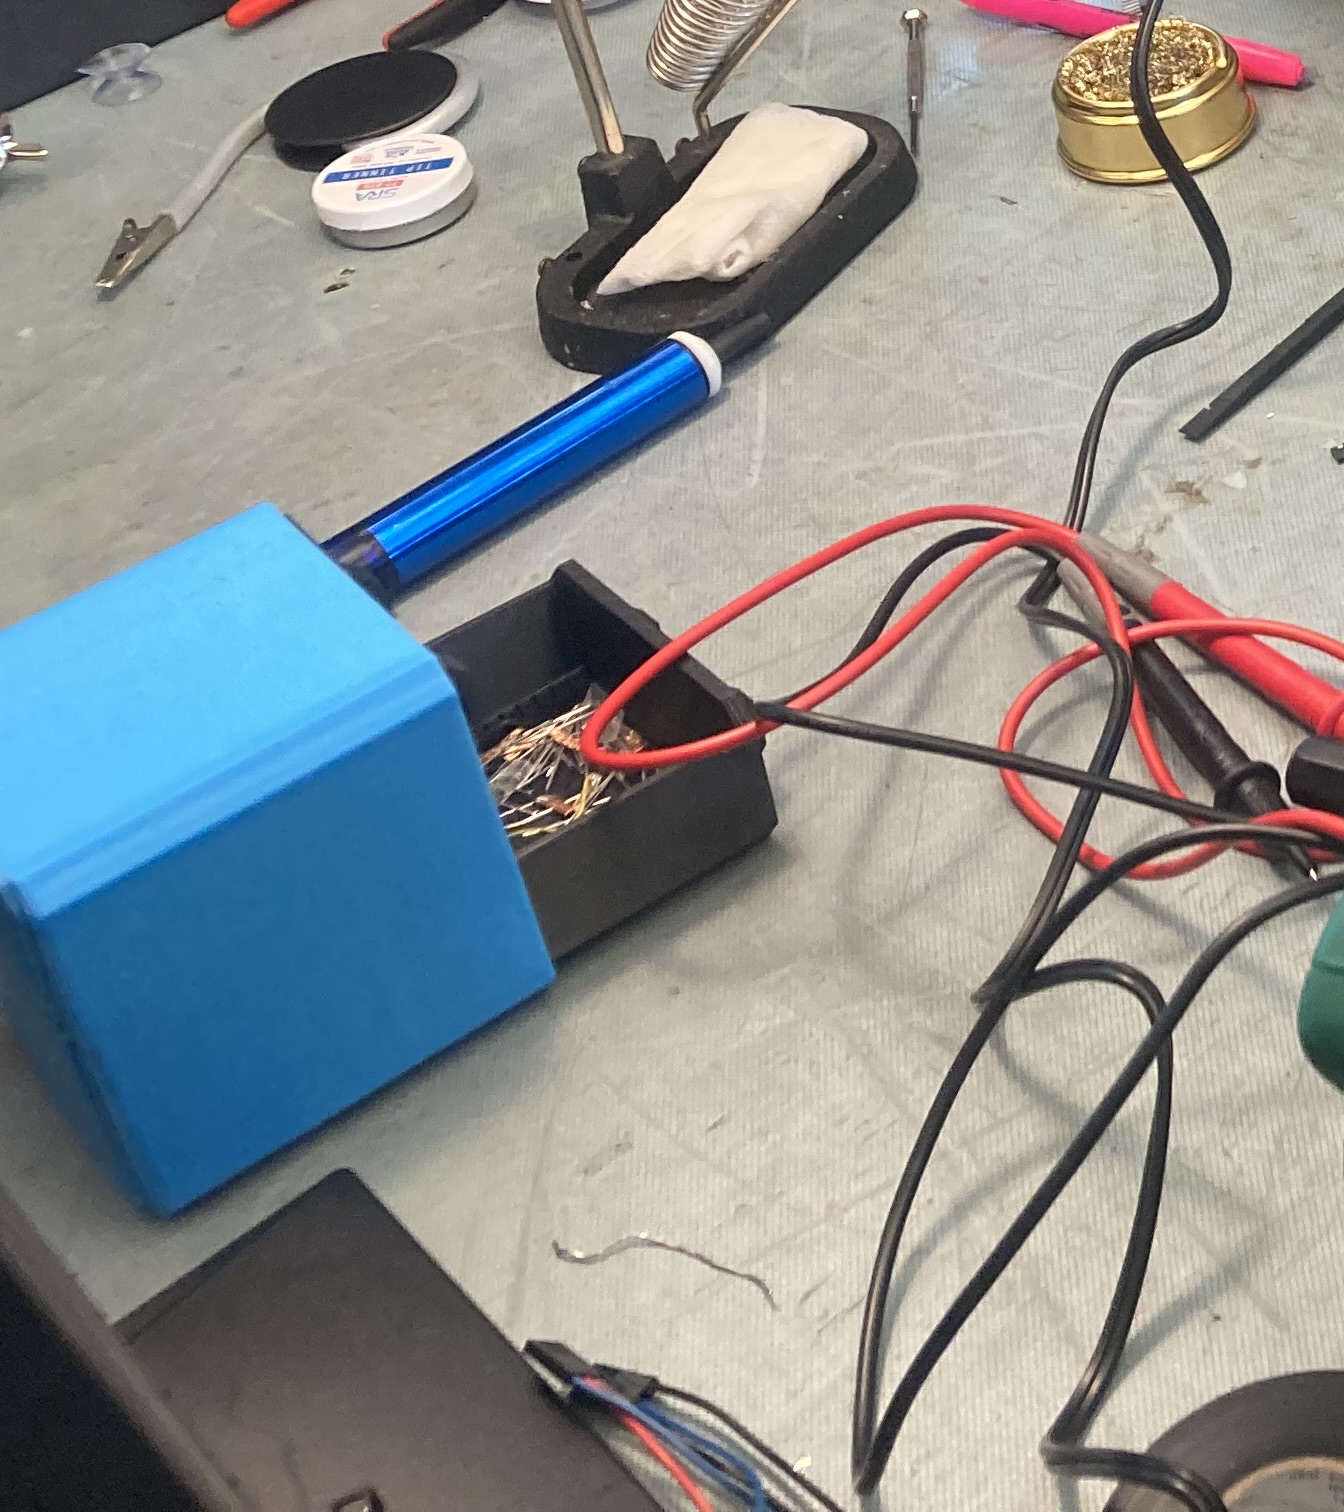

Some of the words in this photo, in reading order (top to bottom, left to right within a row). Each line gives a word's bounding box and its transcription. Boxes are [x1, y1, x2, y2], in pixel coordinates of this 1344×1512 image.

[340, 166, 396, 180] TINNER
[405, 161, 432, 174] TIP
[355, 187, 400, 202] SRA
